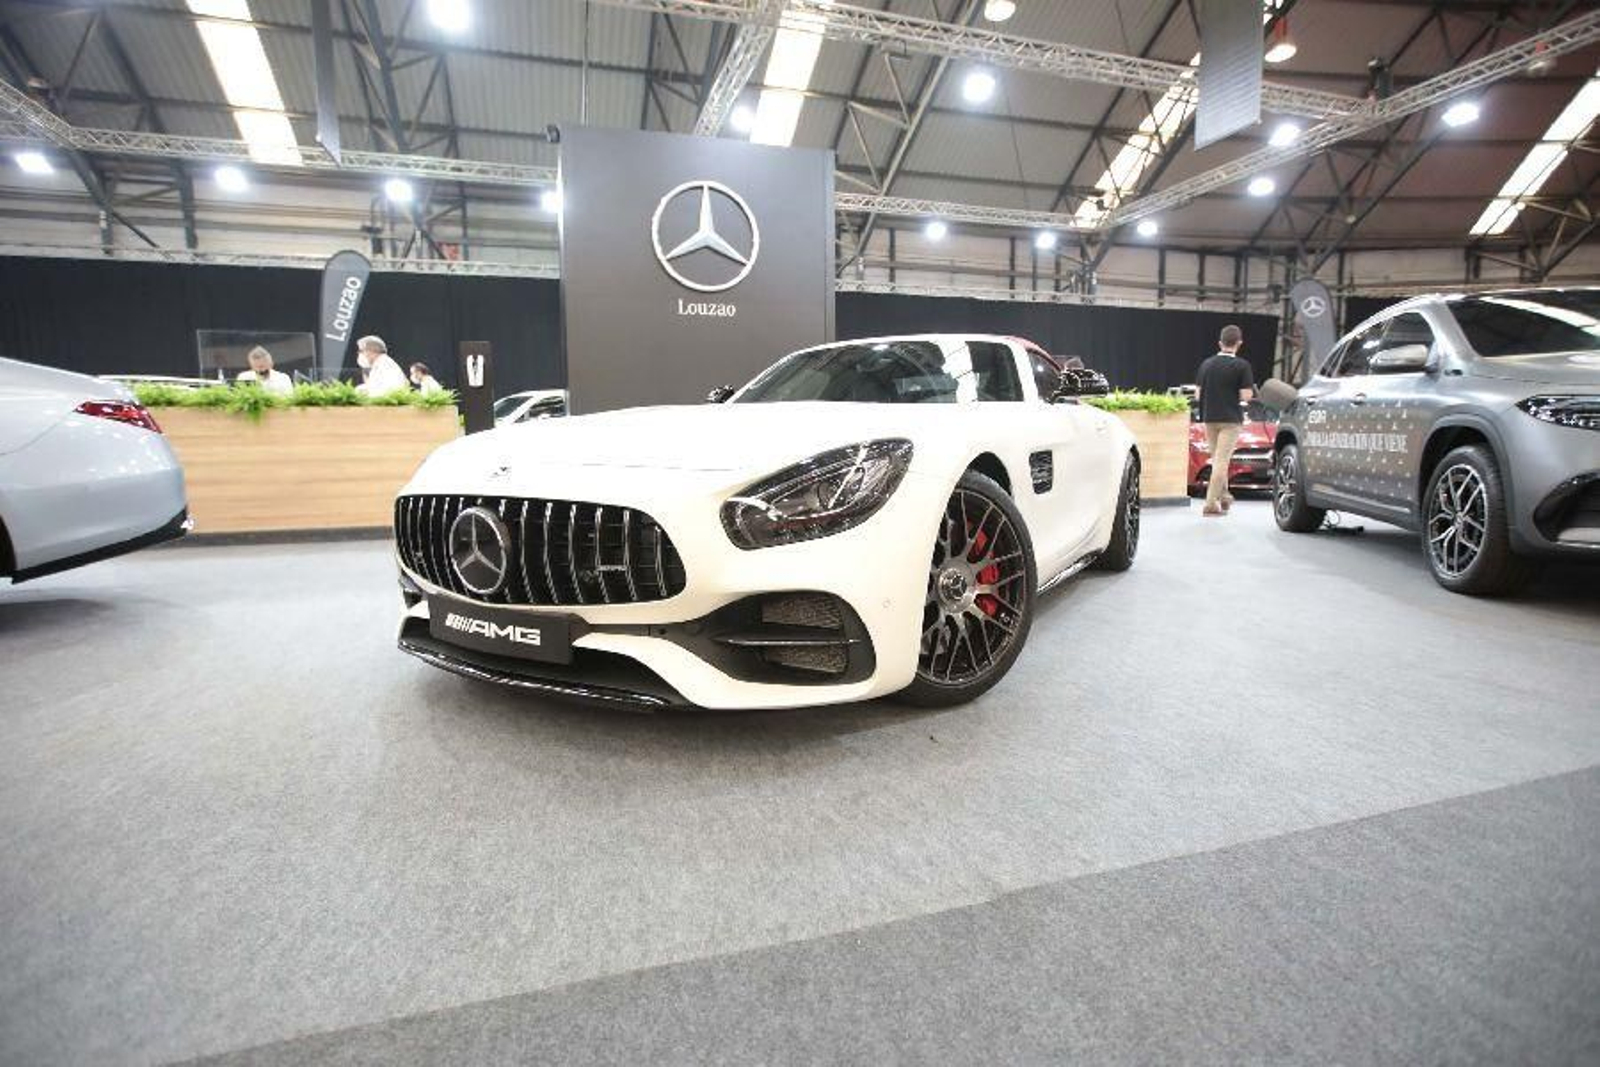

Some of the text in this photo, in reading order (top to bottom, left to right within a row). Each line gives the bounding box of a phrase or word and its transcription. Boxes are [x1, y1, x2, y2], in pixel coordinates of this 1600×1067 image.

[325, 276, 361, 341] Louzao
[677, 298, 736, 317] Louzao
[467, 617, 541, 646] AMG
